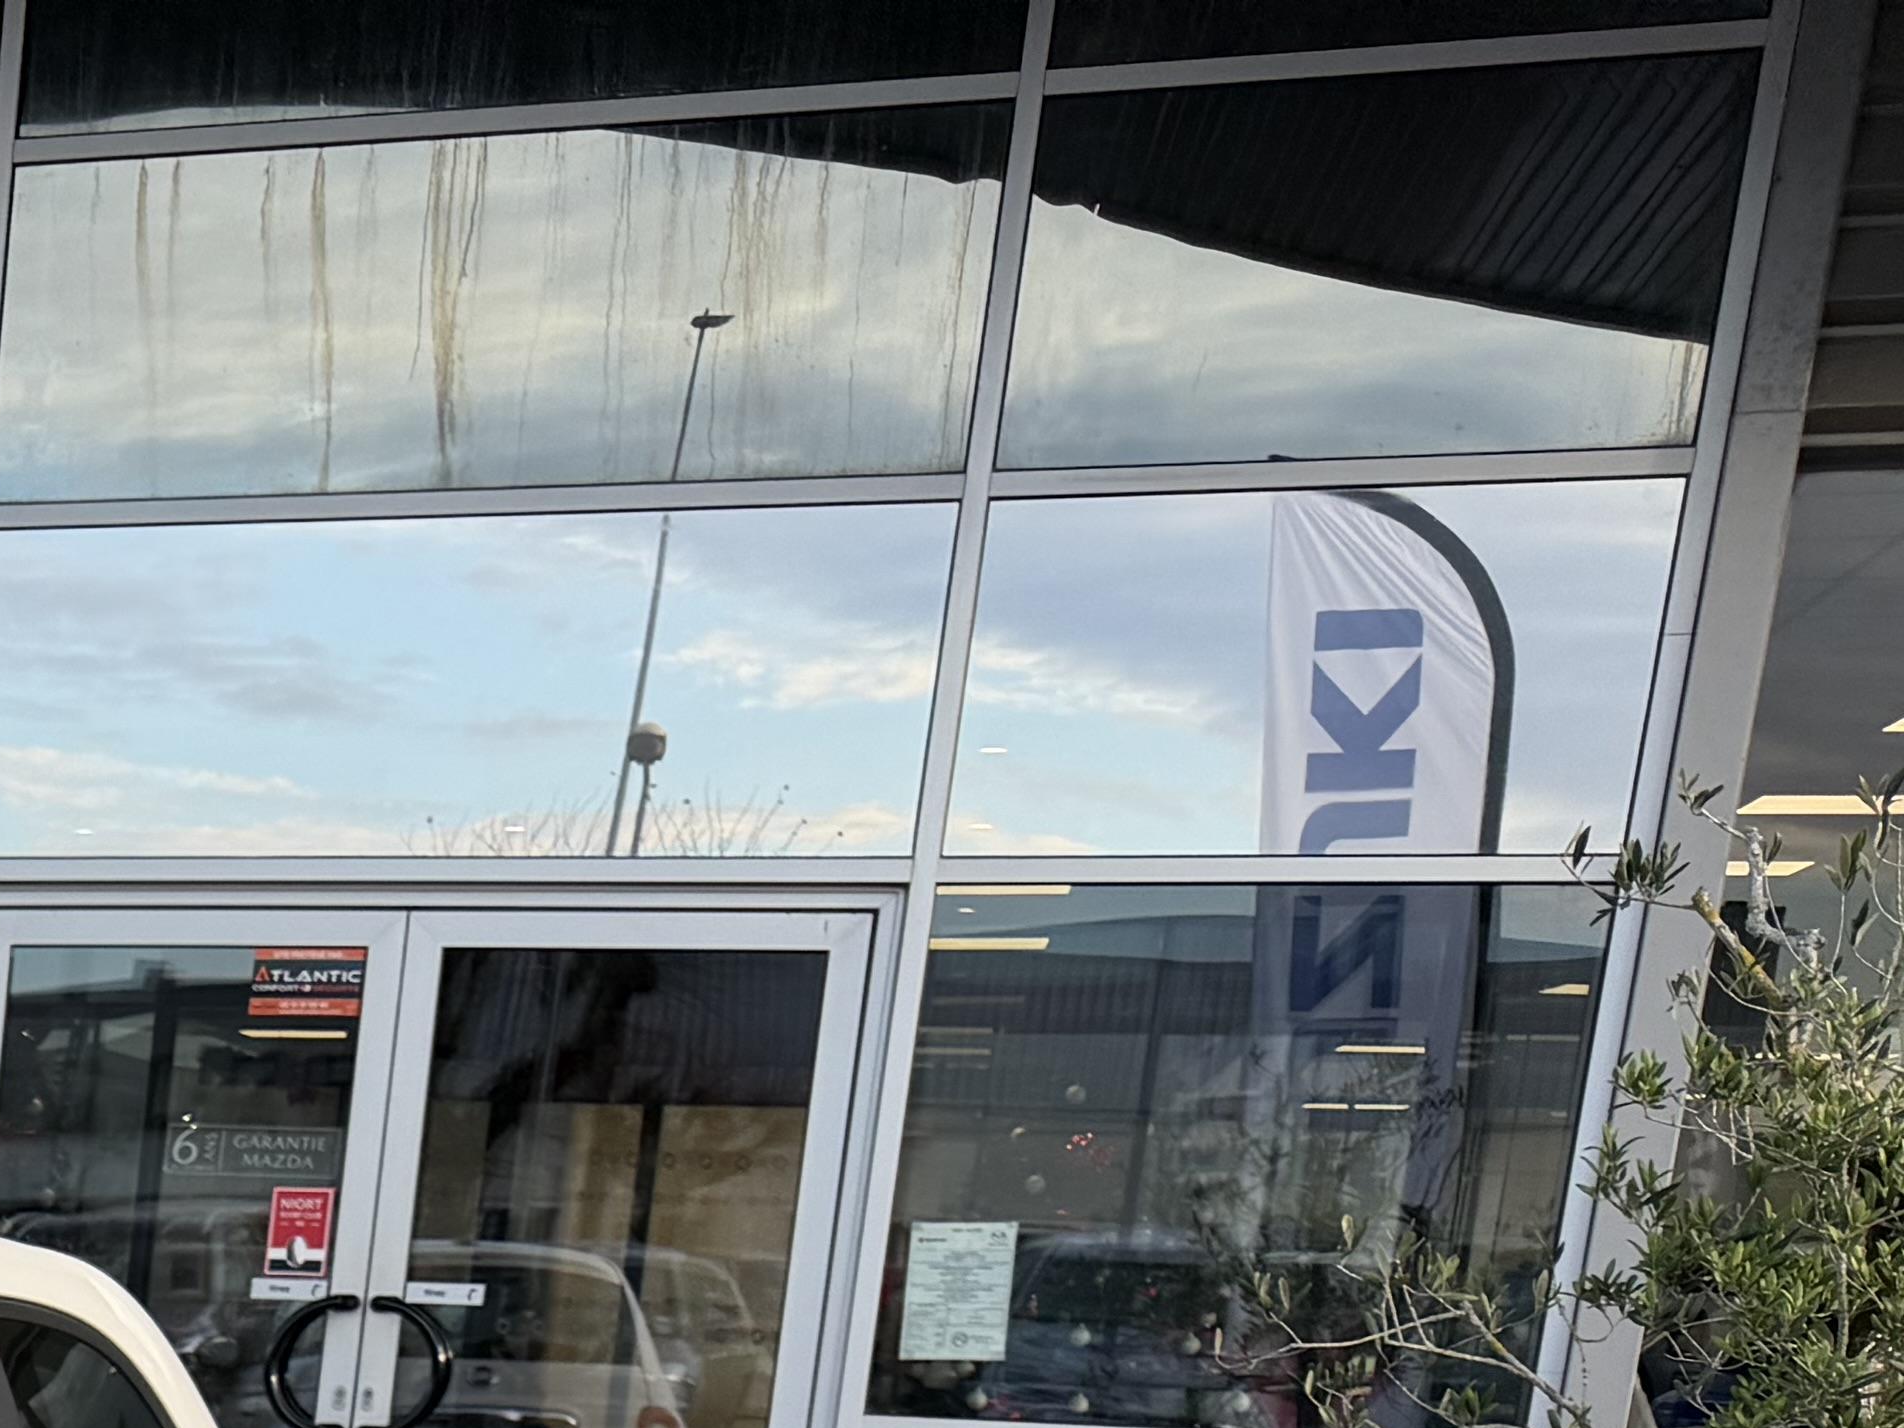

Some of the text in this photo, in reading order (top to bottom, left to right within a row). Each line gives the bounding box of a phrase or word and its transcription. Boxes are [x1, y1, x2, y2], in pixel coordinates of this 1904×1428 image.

[255, 966, 362, 983] ATLANTIC
[172, 1128, 199, 1165] 6
[232, 1134, 328, 1152] GARANTIE
[242, 1153, 315, 1170] MAZDA
